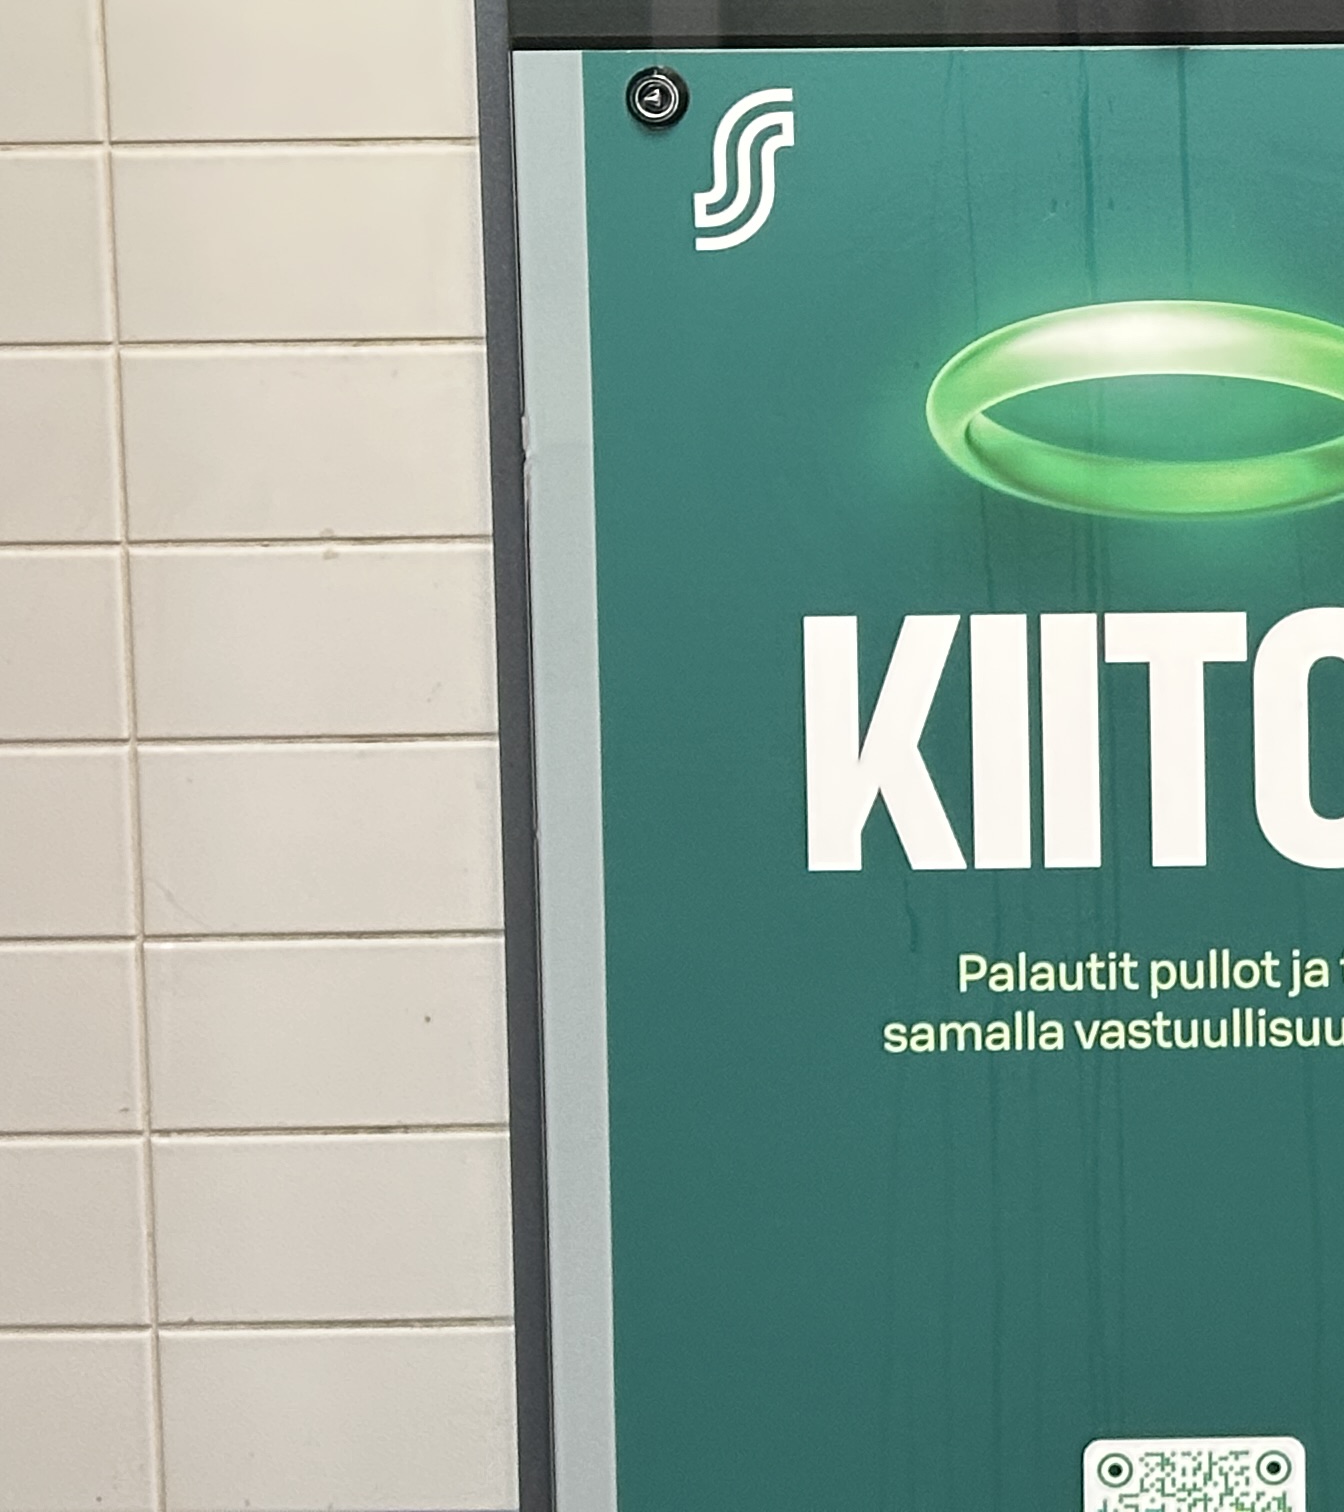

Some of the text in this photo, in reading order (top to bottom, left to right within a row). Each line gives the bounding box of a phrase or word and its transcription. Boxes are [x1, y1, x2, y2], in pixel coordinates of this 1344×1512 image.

[959, 951, 1139, 992] Palautit
[1150, 950, 1281, 999] pullot
[1288, 952, 1329, 998] ja
[883, 1012, 1064, 1053] samalla
